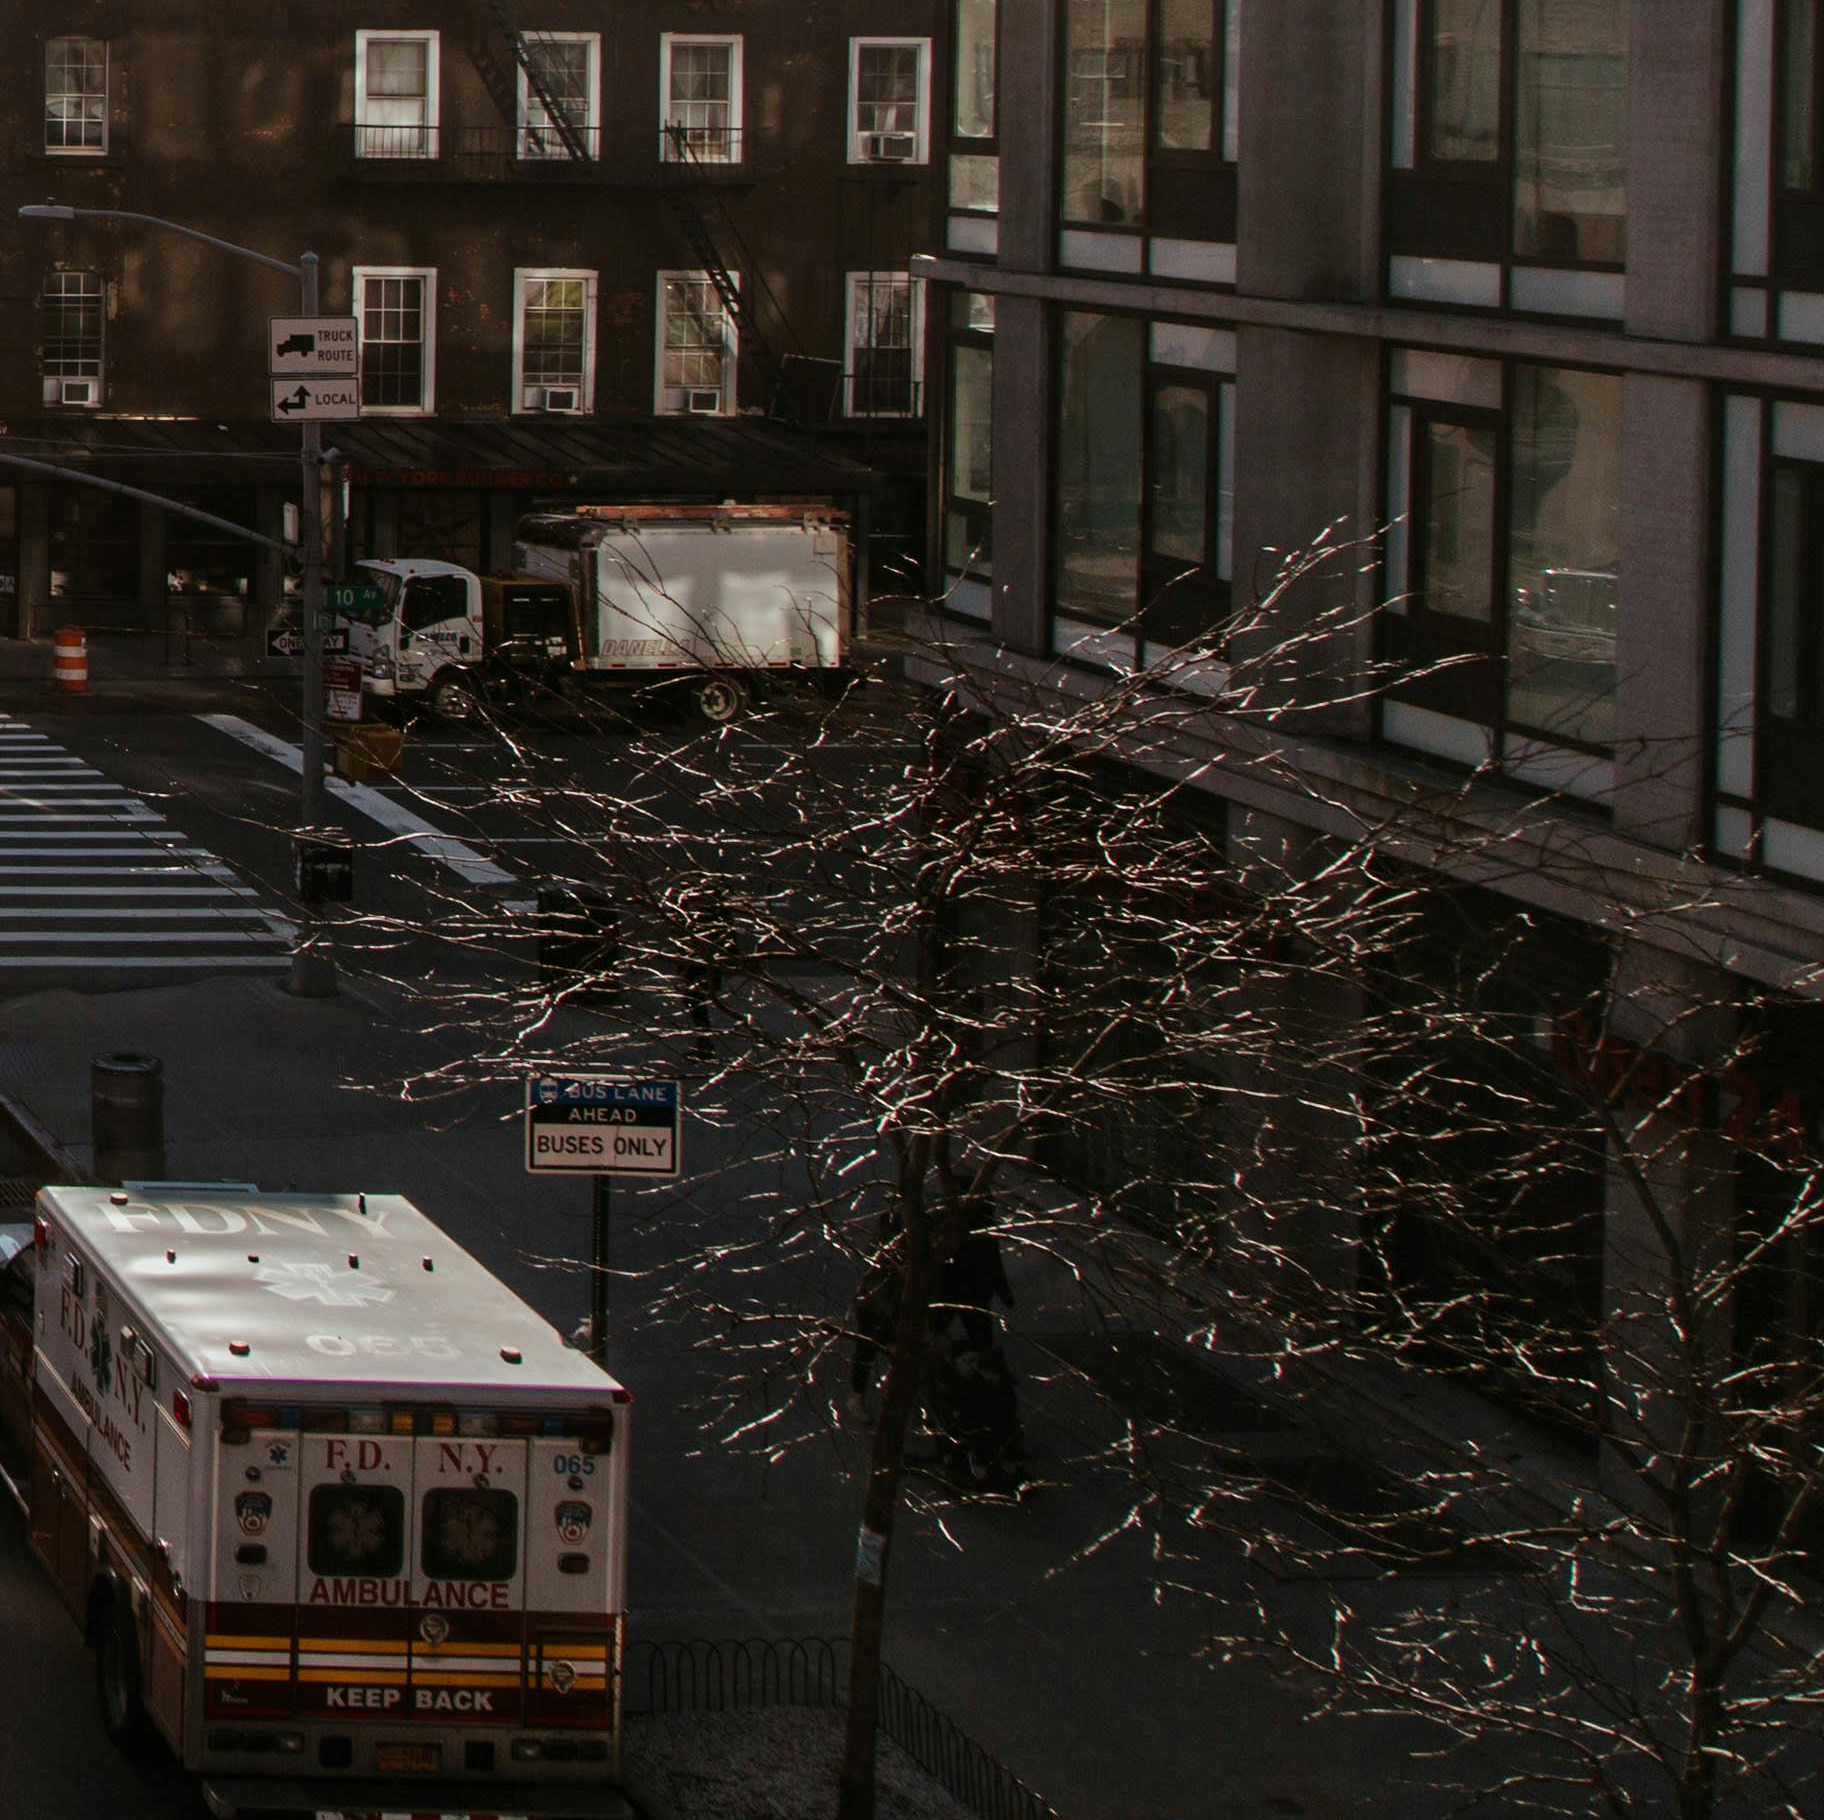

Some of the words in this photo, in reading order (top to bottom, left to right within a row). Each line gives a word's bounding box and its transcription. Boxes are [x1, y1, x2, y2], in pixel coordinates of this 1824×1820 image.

[318, 330, 353, 342] TRUCK
[318, 350, 353, 361] ROUTE
[315, 393, 356, 405] LOCAL
[399, 468, 449, 485] YORK
[335, 588, 354, 606] 10
[569, 1082, 607, 1099] BUS
[614, 1084, 668, 1102] LANE
[569, 1107, 637, 1122] AHEAD
[537, 1135, 604, 1154] BUSES
[613, 1136, 667, 1157] ONLY
[95, 1203, 395, 1238] FDNY
[70, 1371, 132, 1473] AMBULANCE
[325, 1438, 391, 1472] F.D.
[438, 1442, 505, 1475] N.Y.
[554, 1454, 596, 1477] 065
[309, 1578, 511, 1609] AMBULANCE
[326, 1687, 402, 1709] KEEP
[415, 1689, 494, 1712] BACK
